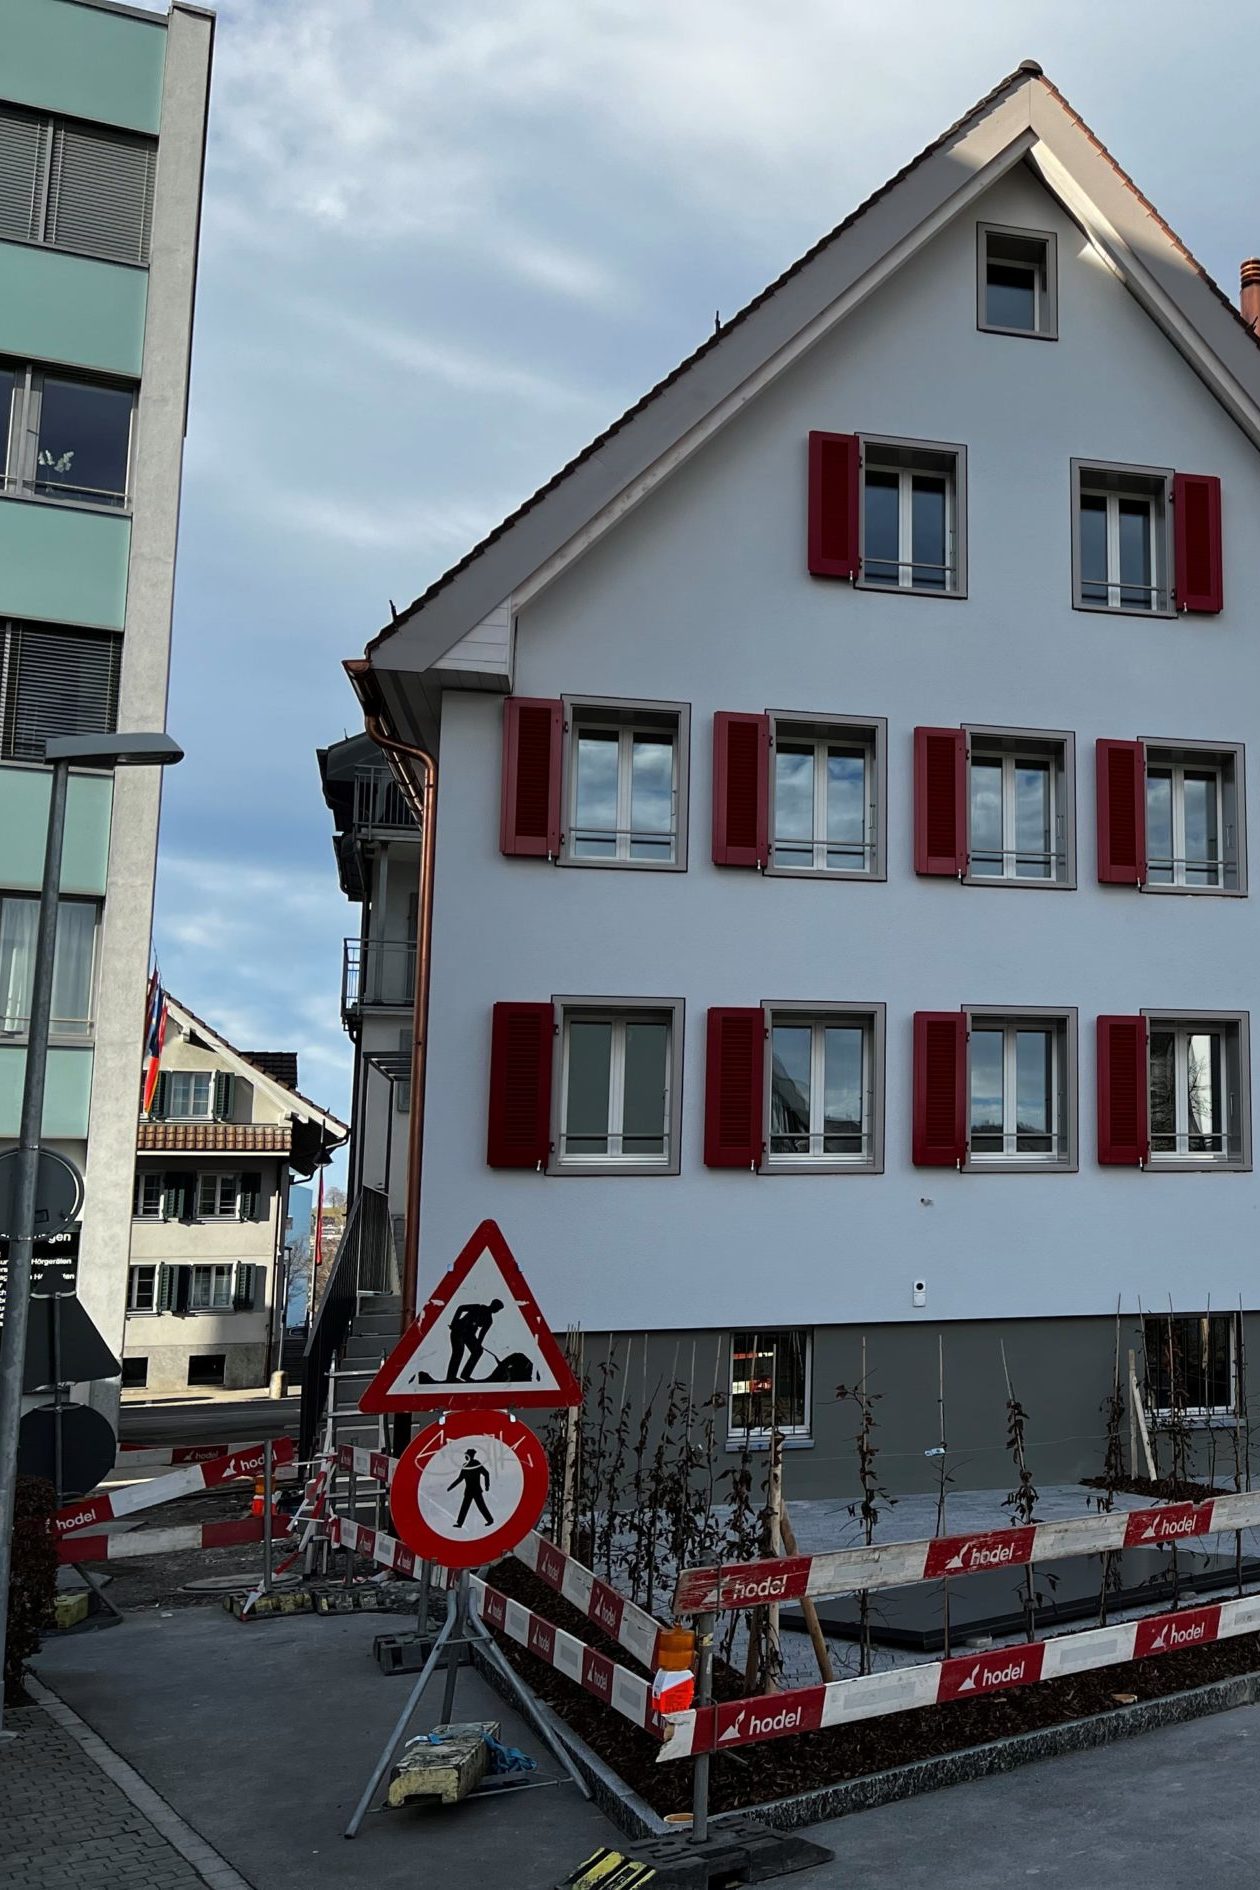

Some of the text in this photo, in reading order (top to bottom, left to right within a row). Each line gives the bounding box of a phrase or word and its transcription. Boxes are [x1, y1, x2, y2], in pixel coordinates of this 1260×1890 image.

[240, 1449, 278, 1471] hodl
[56, 1509, 96, 1531] hodel
[1161, 1514, 1197, 1536] hodel
[970, 1543, 1014, 1566] hodel
[733, 1574, 788, 1599] hodel
[601, 1599, 617, 1627] hodel
[537, 1629, 550, 1653] hodel
[1170, 1622, 1204, 1645] hodel
[593, 1666, 608, 1690] hodel
[982, 1661, 1025, 1687] hodel
[749, 1706, 802, 1735] hodel
